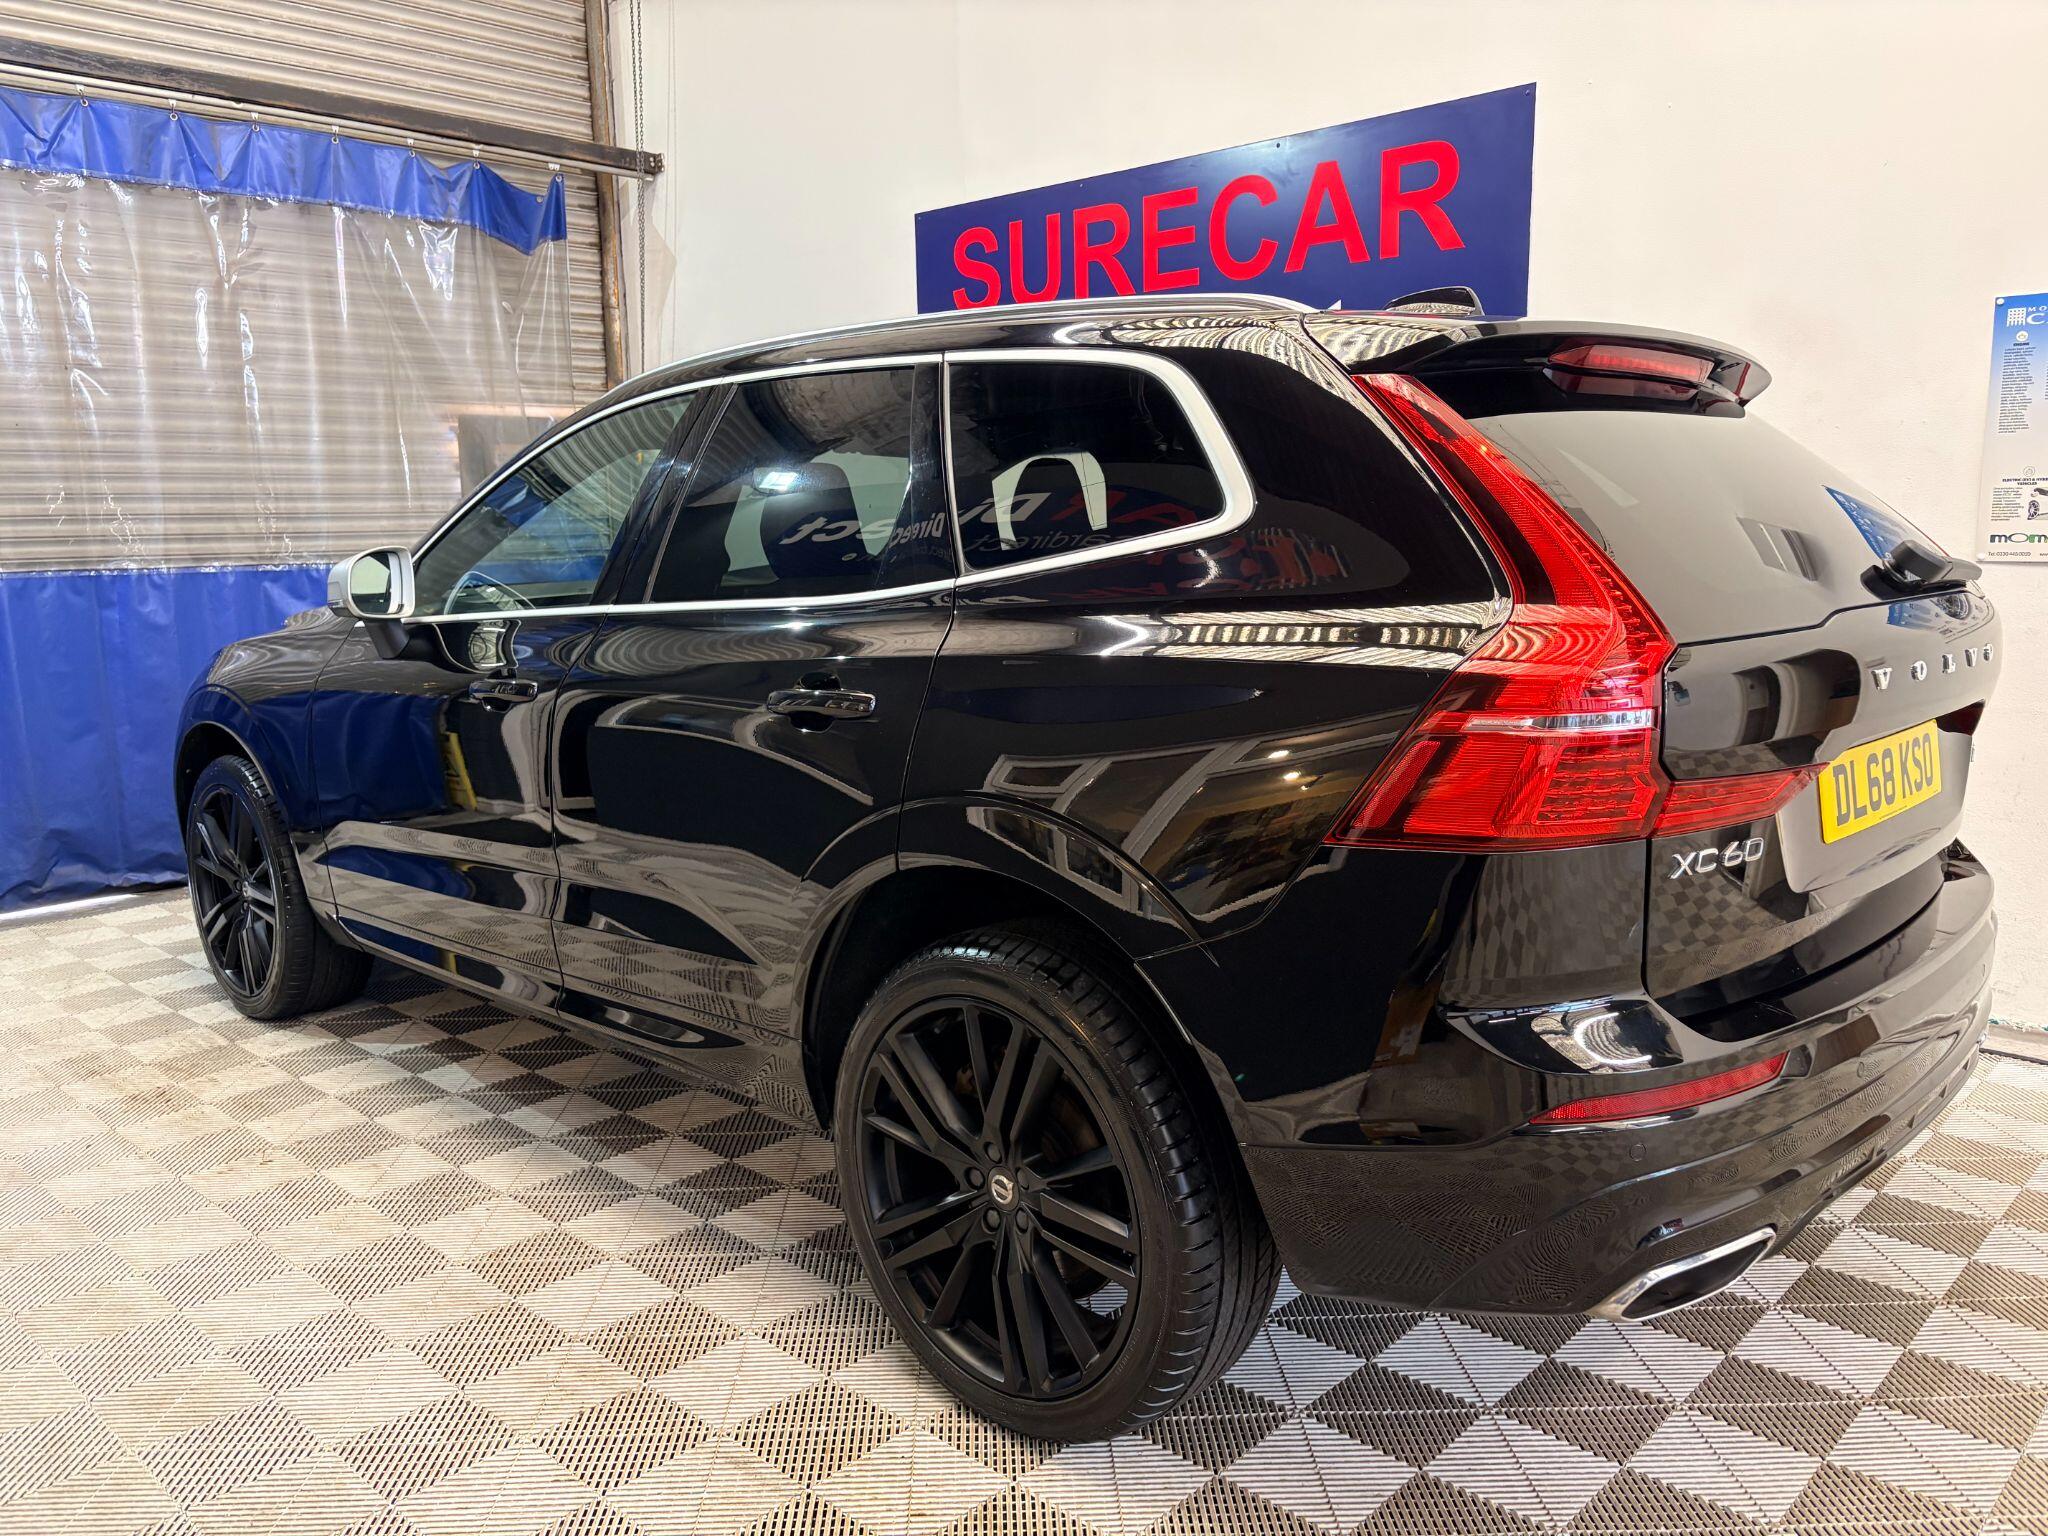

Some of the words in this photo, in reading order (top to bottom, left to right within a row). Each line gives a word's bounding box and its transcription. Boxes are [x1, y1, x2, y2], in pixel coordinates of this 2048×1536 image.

[953, 140, 1466, 310] SURECAR
[1871, 643, 1995, 691] VOLVO
[1832, 747, 1896, 828] DL68
[1899, 732, 1934, 799] KSO
[1669, 837, 1765, 879] XC60
